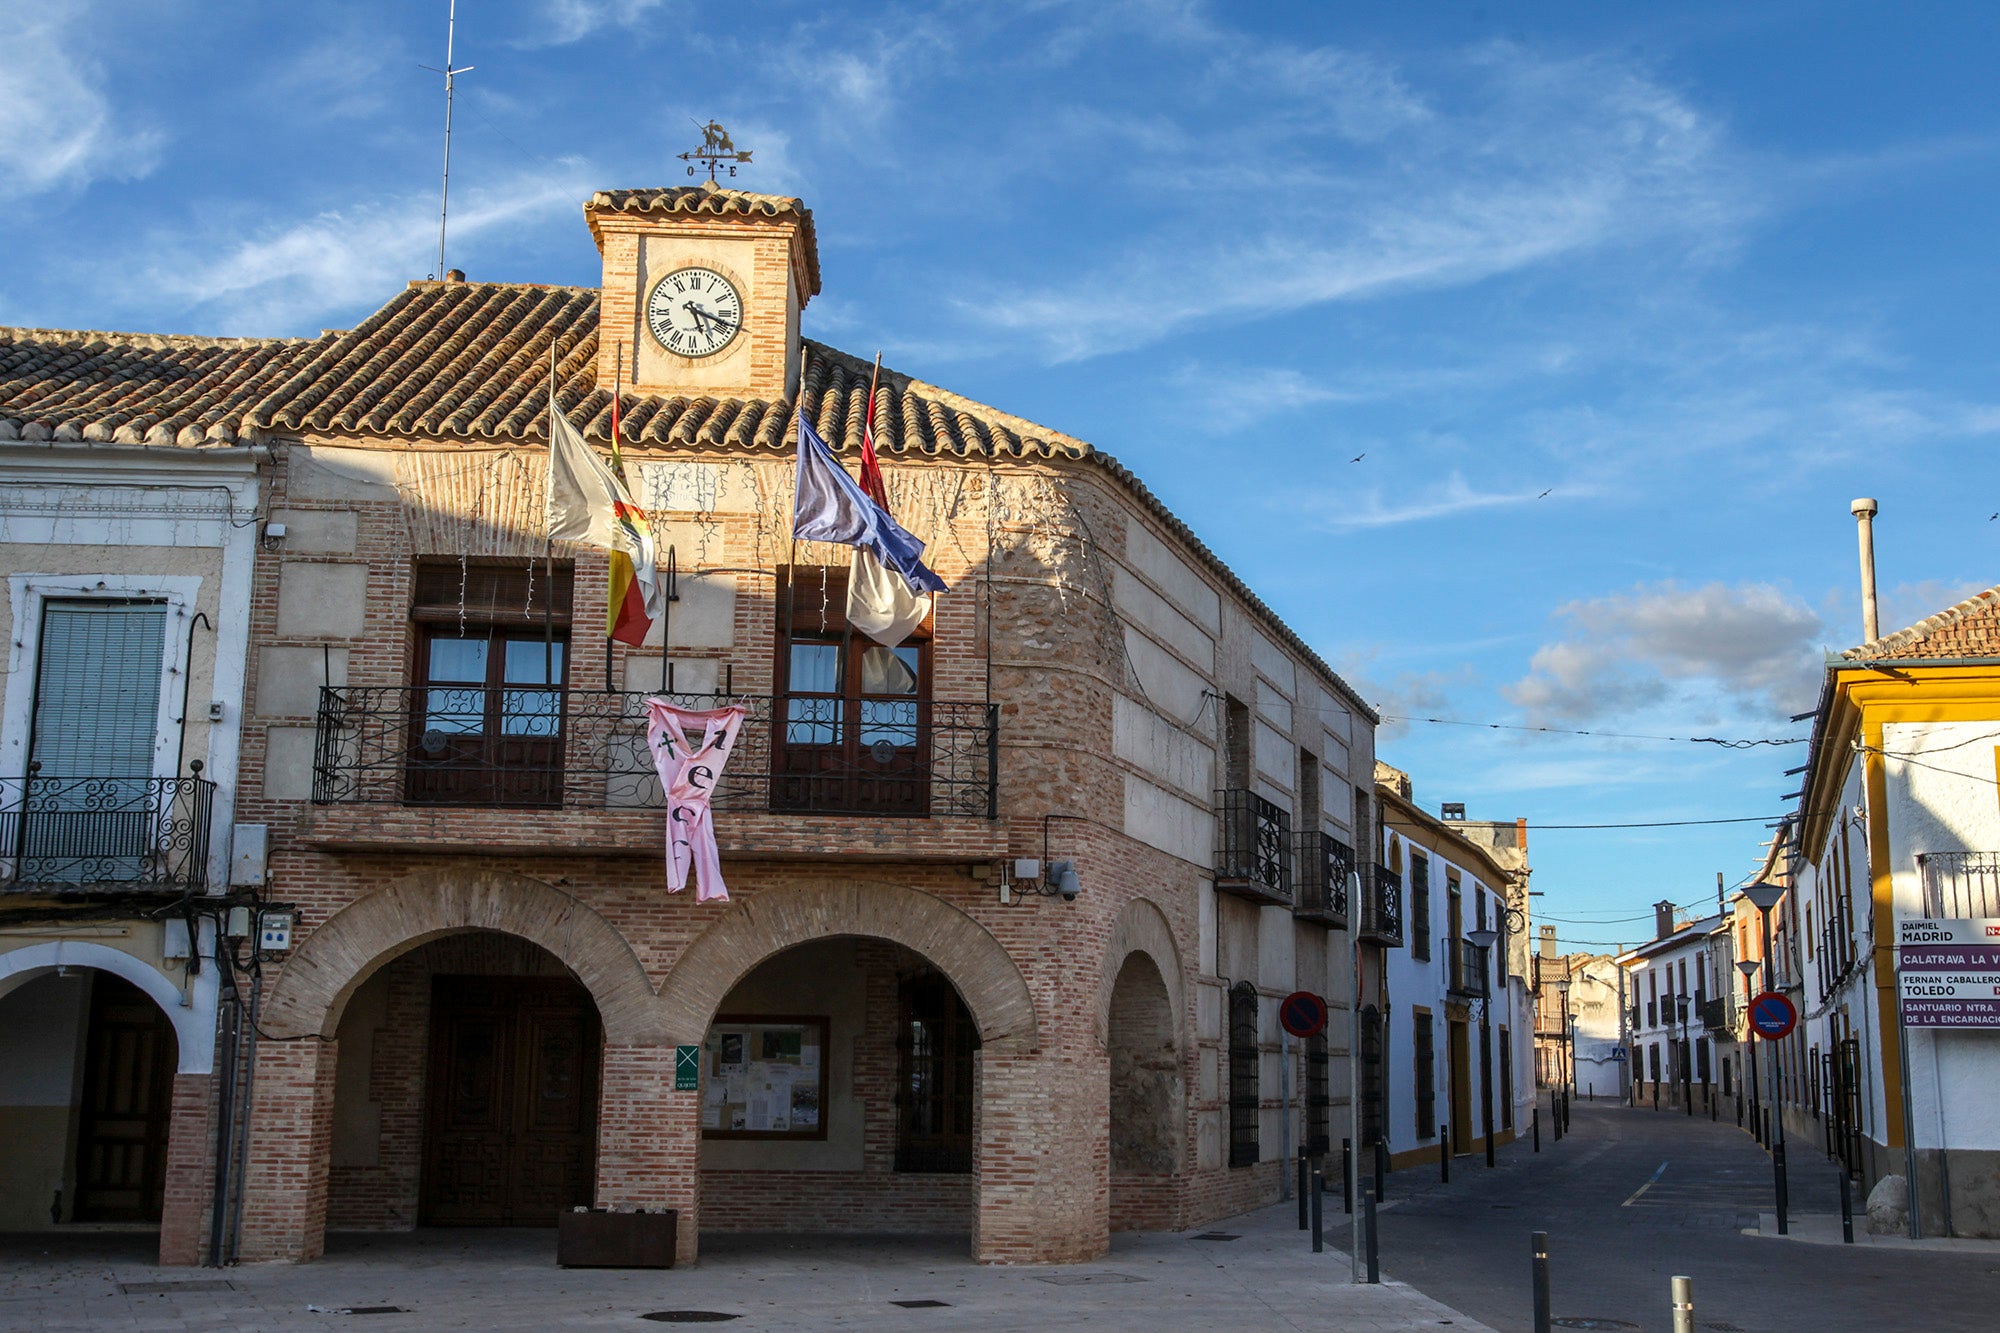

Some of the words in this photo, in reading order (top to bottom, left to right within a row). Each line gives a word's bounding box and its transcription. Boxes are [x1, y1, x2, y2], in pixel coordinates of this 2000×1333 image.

[687, 166, 694, 176] O
[730, 166, 737, 177] E
[673, 280, 686, 294] XI
[690, 277, 701, 290] XII
[706, 281, 715, 293] I
[661, 292, 674, 303] X
[714, 294, 728, 303] II
[656, 308, 670, 316] IX
[658, 318, 674, 334] VIII
[669, 330, 684, 346] VII
[688, 335, 697, 349] VI
[705, 333, 714, 345] V
[1902, 922, 1940, 931] DAIMIEL
[1987, 927, 2000, 935] N-
[1902, 931, 1954, 942] MADRID
[1902, 955, 1966, 965] CALATRAVA
[1971, 955, 1986, 965] LA
[1992, 955, 2000, 964] V
[1903, 976, 1942, 984] FERNAN
[1946, 976, 2000, 984] CABALLERO
[1905, 985, 1955, 996] TOLEDO
[1906, 1003, 1962, 1012] SANTUARIO
[1966, 1003, 1997, 1012] NTRA.
[1906, 1015, 1919, 1023] DE
[1923, 1015, 1937, 1023] LA
[1941, 1015, 2000, 1024] ENCARNACI
